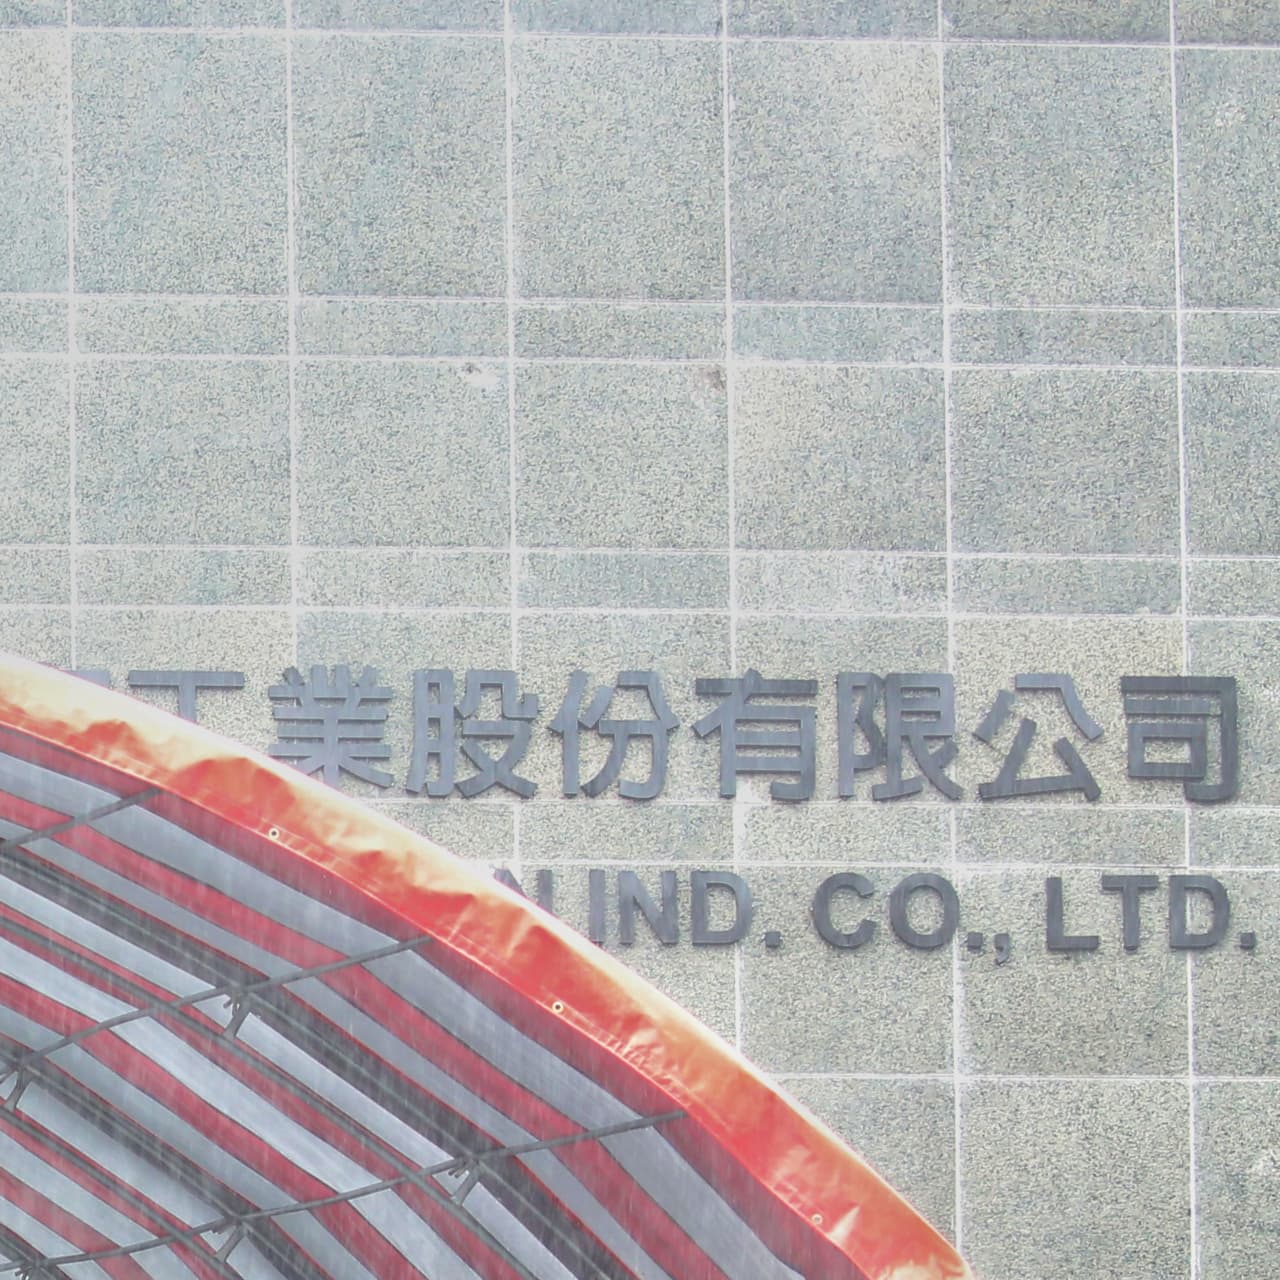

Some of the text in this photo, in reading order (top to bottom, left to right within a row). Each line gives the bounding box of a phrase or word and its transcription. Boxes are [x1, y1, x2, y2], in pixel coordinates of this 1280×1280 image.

[60, 664, 1239, 802] 業股份有限公司
[589, 868, 782, 948] IND.
[812, 871, 1010, 966] CO.,
[1046, 874, 1256, 951] LTD.
